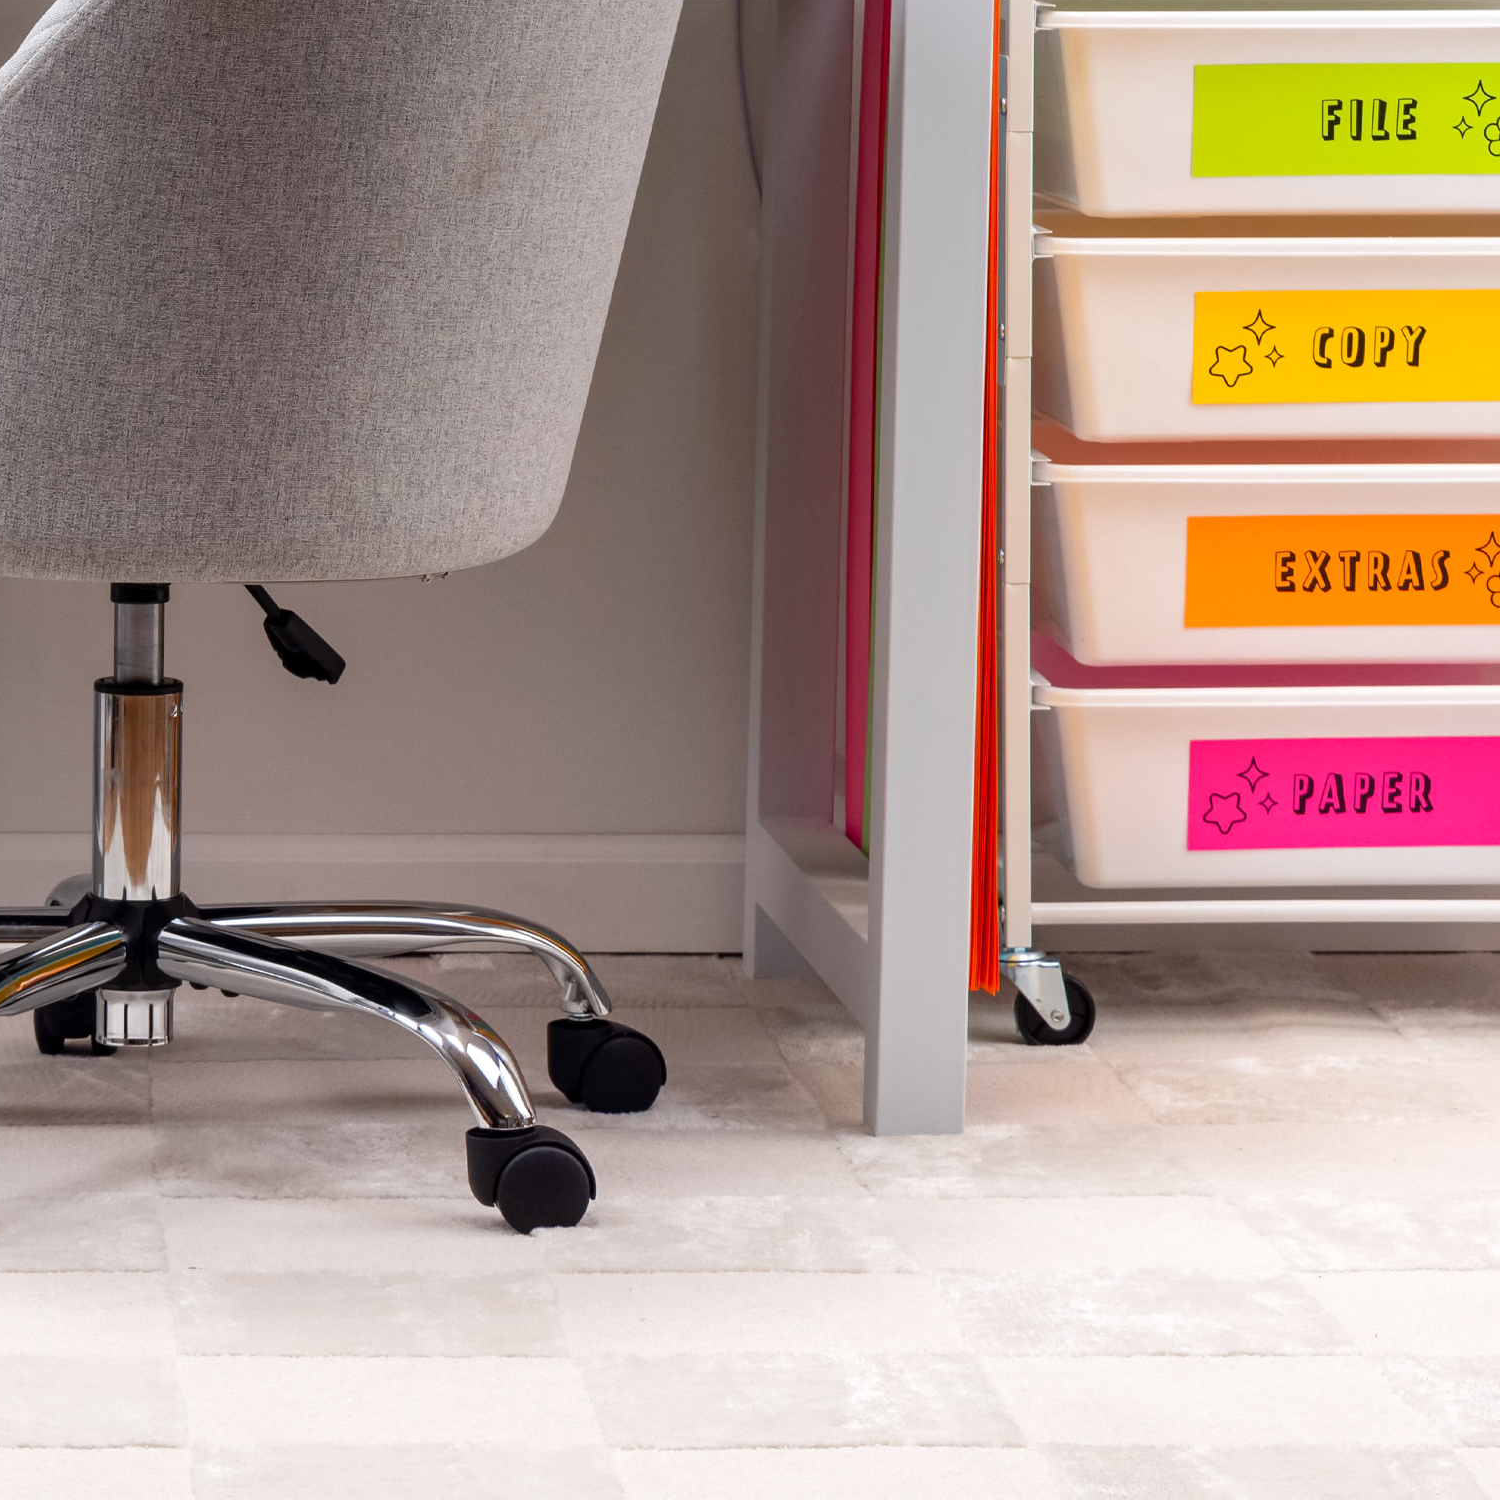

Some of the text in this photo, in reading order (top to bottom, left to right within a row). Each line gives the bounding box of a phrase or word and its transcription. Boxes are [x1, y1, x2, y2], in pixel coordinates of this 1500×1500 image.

[1320, 96, 1419, 142] FILE
[1311, 324, 1427, 369] COPY
[1273, 548, 1453, 593] EXTRAS
[1292, 770, 1436, 815] PAPER
